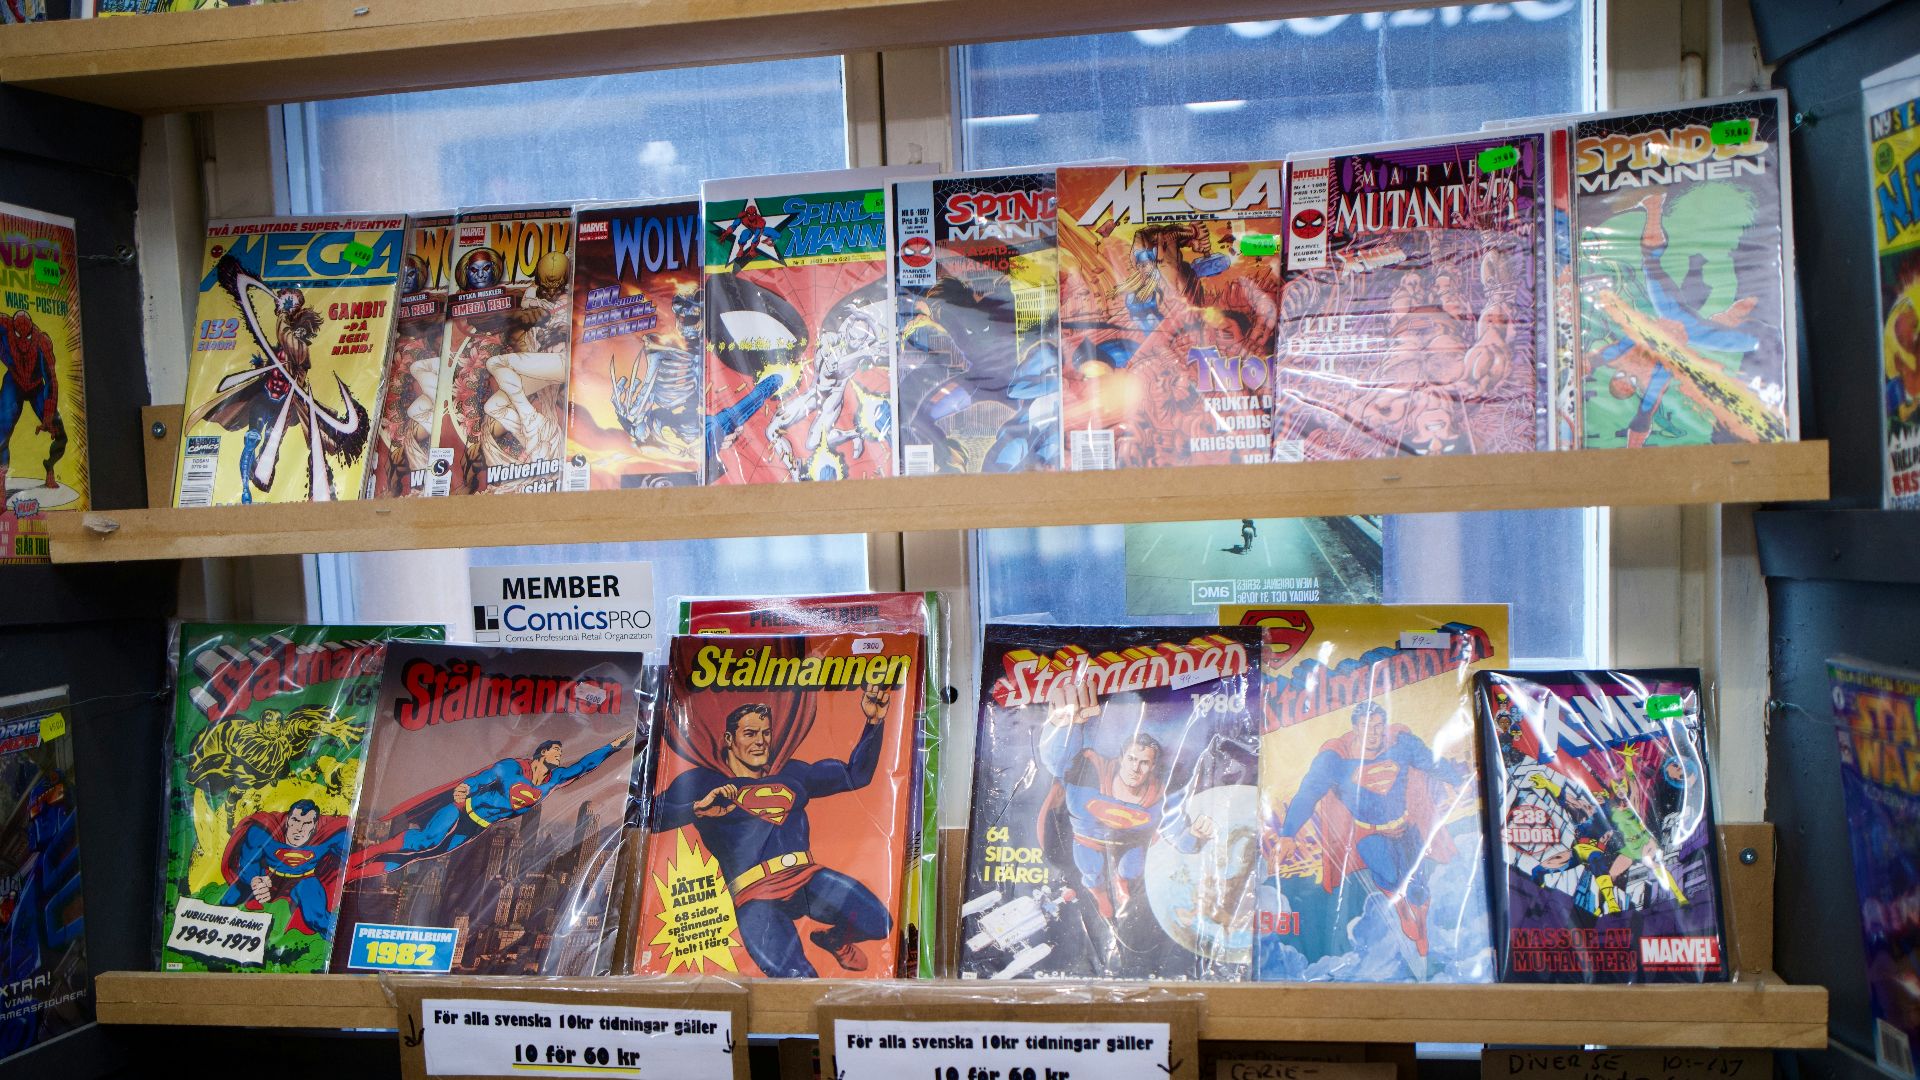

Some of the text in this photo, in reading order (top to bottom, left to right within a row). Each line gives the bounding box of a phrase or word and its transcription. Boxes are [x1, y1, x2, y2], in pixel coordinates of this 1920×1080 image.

[1578, 157, 1766, 194] MANNEN
[1076, 168, 1282, 227] MEGA
[208, 226, 229, 237] TVÅ
[231, 222, 298, 236] AVSLUTADE
[300, 218, 402, 231] SUPER-ÄVENTYR!
[578, 222, 608, 234] MARVEL
[1147, 213, 1220, 223] MARVEL
[460, 228, 486, 236] MARVEL
[200, 230, 405, 292] MEGA
[458, 290, 477, 301] RYSKA
[328, 300, 388, 321] GAMBIT
[411, 302, 435, 316] RED!
[452, 297, 512, 317] OMEGA RED!
[200, 317, 240, 340] 132
[338, 332, 371, 344] EGEN
[197, 340, 237, 352] SIDOR!
[331, 343, 375, 356] HAND!
[1204, 396, 1260, 412] FRUKTA
[487, 458, 560, 484] Wolverine
[17, 500, 38, 515] PLUS
[502, 574, 620, 600] MEMBER
[503, 604, 652, 632] ComicsPRO
[505, 631, 653, 643] Comics Professional Retail Organization
[690, 645, 912, 690] Stålmannen
[1513, 809, 1547, 825] 238
[986, 826, 1010, 844] 64
[1501, 827, 1560, 844] SIDOR!
[984, 846, 1044, 865] SIDOR
[983, 862, 1050, 885] I FÄRG!
[670, 875, 715, 897] JÄTTE
[672, 889, 717, 909] ALBUM
[179, 908, 265, 932] JUBILEUMS-ÅRGÅNG
[674, 905, 719, 923] 68 sidor
[357, 927, 453, 944] PRESENTALBUM
[668, 913, 730, 938] spännande
[677, 926, 722, 944] äventyr
[176, 925, 262, 952] 1949-1979
[674, 943, 698, 957] helt
[704, 936, 730, 949] färg
[1511, 927, 1632, 950] MASSOR AV
[366, 940, 437, 966] 1982
[1641, 938, 1716, 963] MARVEL
[1512, 949, 1638, 973] MUTANTER!
[5, 994, 33, 1008] VINN
[434, 1009, 718, 1038] För alla svenska 10kr tidningar gäller
[847, 1034, 1154, 1053] För alla svenska 10kr tidningar gäller
[514, 1044, 641, 1067] 10 för 60 kr
[934, 1066, 1071, 1080] 10 för 60 kr
